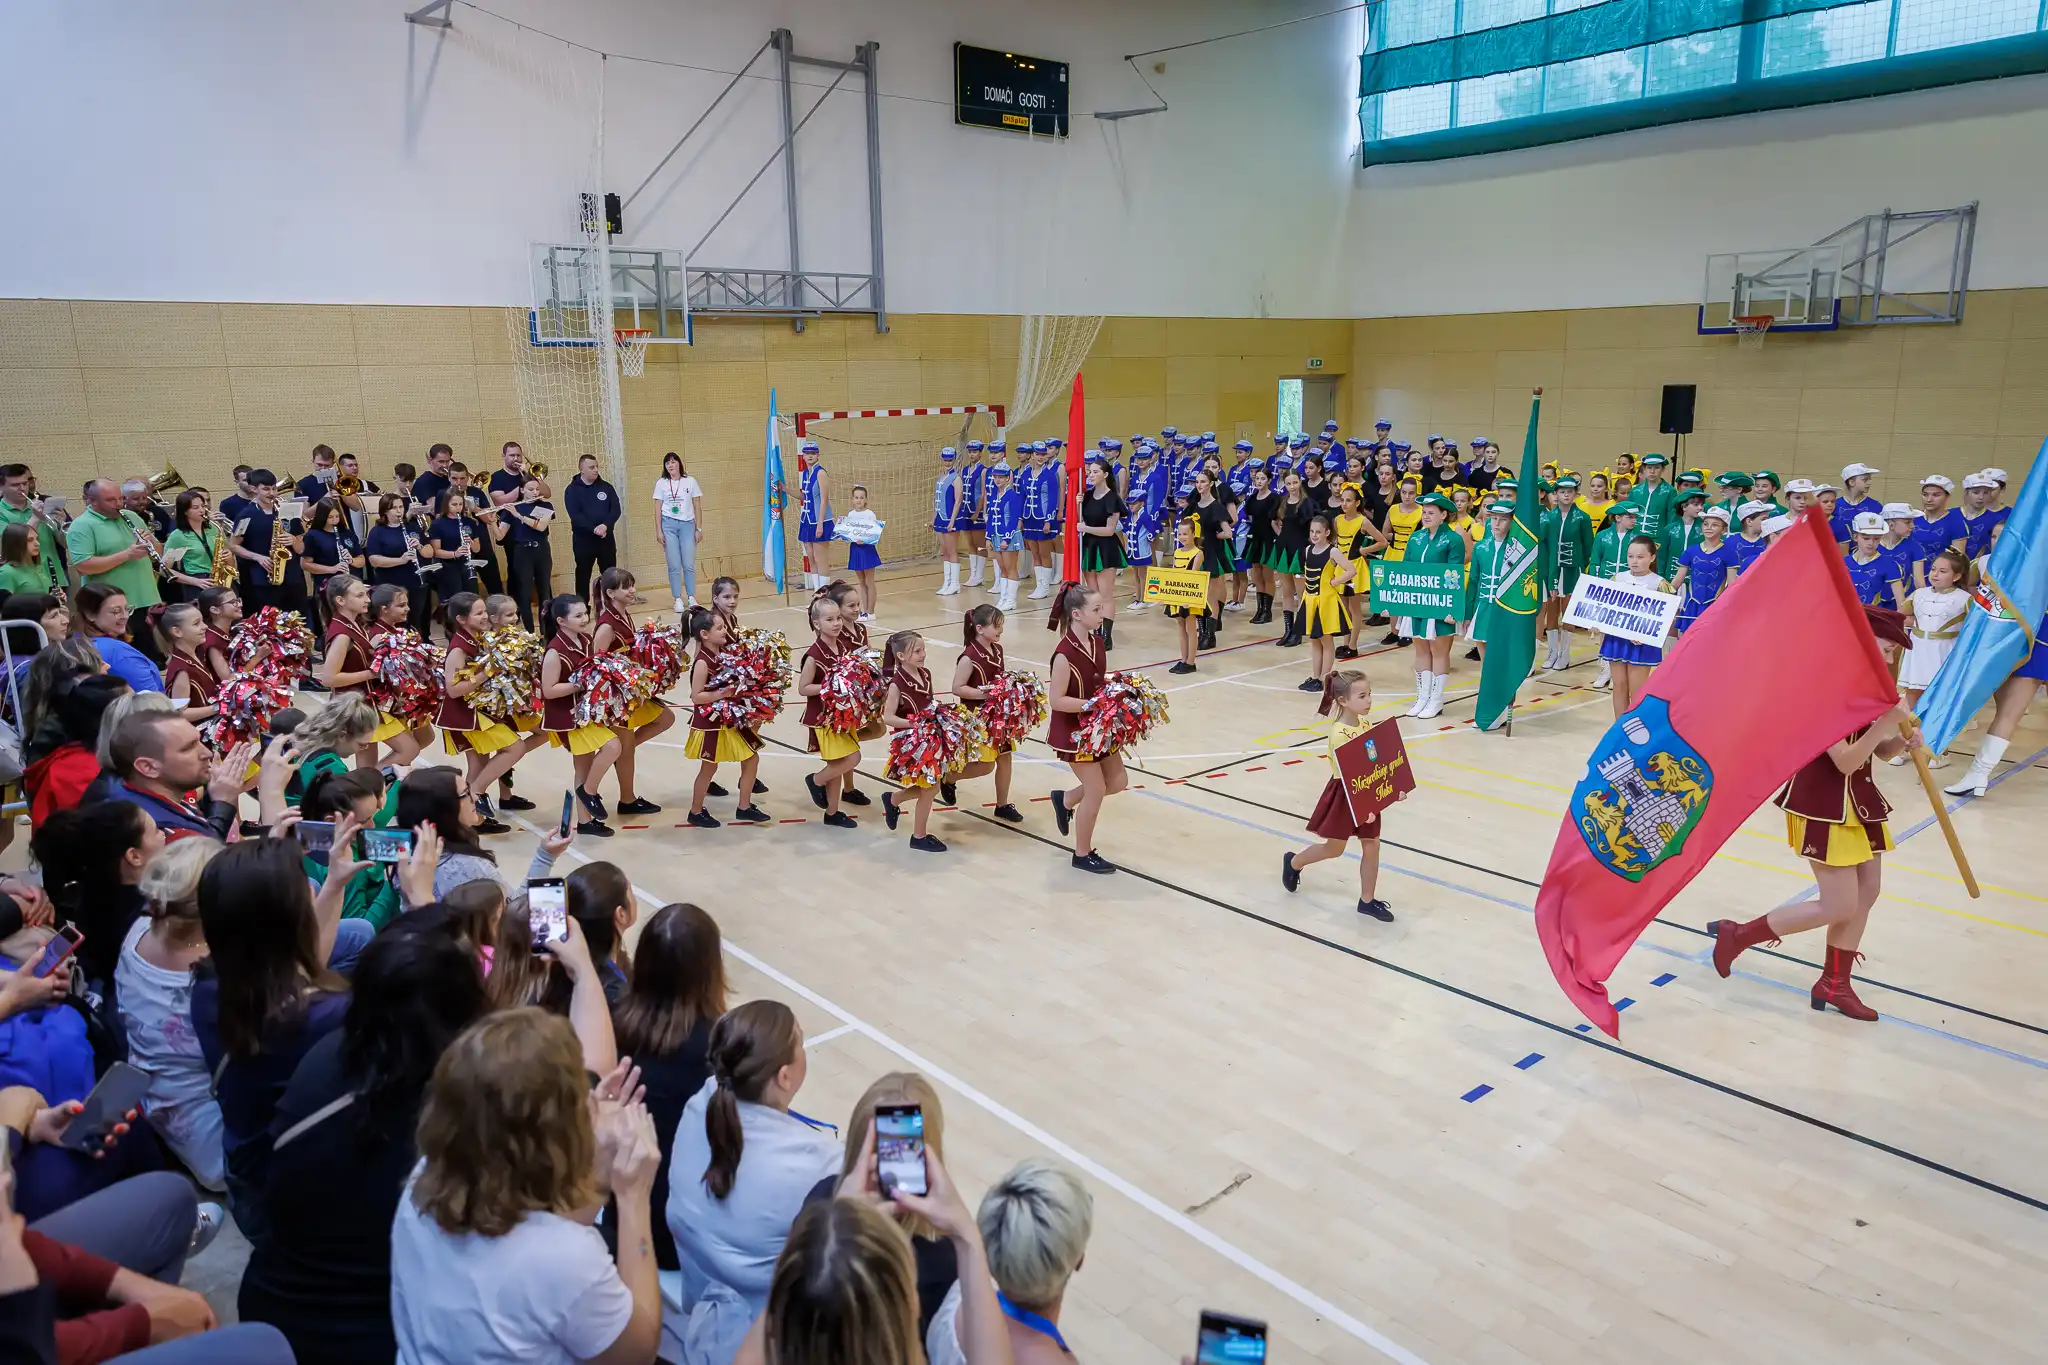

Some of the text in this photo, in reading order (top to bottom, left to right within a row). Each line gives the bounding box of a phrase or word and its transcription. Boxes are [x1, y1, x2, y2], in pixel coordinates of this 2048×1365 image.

[1018, 92, 1046, 109] GOSTI
[1165, 580, 1200, 590] BARBANSKE
[1388, 571, 1441, 589] ČABARSKE
[1160, 587, 1203, 598] MAŽORETKINJE
[1379, 588, 1453, 608] MAŽORETKINJE
[1584, 583, 1667, 617] DARUVARSKE
[1573, 601, 1664, 638] MAŽORETKINJE
